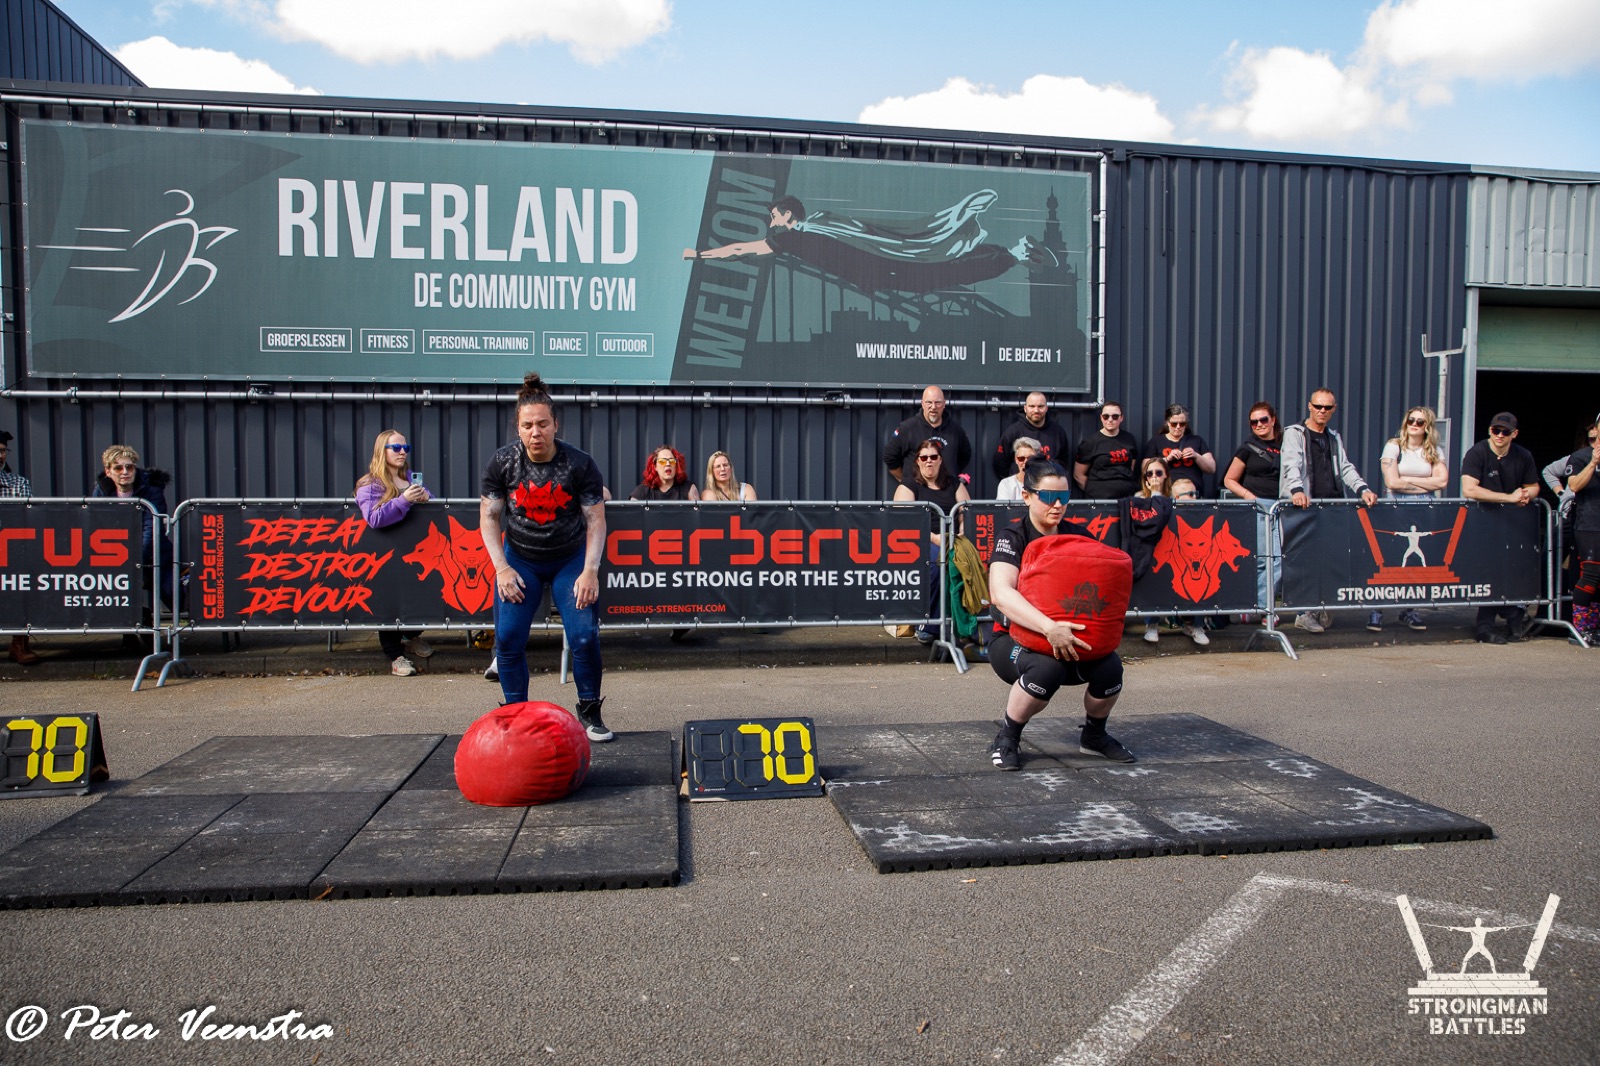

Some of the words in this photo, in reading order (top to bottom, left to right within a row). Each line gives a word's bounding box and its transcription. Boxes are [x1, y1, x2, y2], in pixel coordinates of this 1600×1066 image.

[279, 177, 638, 264] RIVERLAND
[414, 272, 443, 308] DE
[449, 273, 583, 310] COMMUNITY
[590, 276, 636, 311] GYM
[267, 333, 345, 347] GROEPSLESSEN
[368, 335, 408, 349] FITNESS
[429, 335, 480, 350] PERSONAL
[483, 336, 528, 351] TRAINING
[550, 337, 582, 351] DANCE
[602, 339, 648, 352] OUTDOOR
[856, 342, 967, 361] WWW.RIVERLAND.NU
[999, 347, 1012, 362] DE
[1015, 348, 1051, 363] BIEZEN
[1056, 349, 1061, 363] 1
[235, 514, 368, 550] DEFEAT
[235, 547, 395, 582] DESTROY
[0, 574, 31, 591] HE
[37, 573, 129, 591] STRONG
[607, 572, 667, 588] MADE
[672, 571, 753, 588] STRONG
[758, 570, 797, 587] FOR
[801, 570, 838, 587] THE
[843, 569, 921, 586] STRONG
[64, 595, 92, 607] EST.
[95, 595, 129, 607] 2012
[235, 582, 374, 617] DEVOUR
[865, 589, 889, 600] EST.
[892, 589, 920, 600] 2012
[1337, 586, 1426, 601] STRONGMAN
[1430, 584, 1491, 599] BATTLES
[607, 604, 726, 614] CERBERUS-STRENGTH.COM
[6, 716, 88, 783] 70
[737, 722, 815, 785] 70
